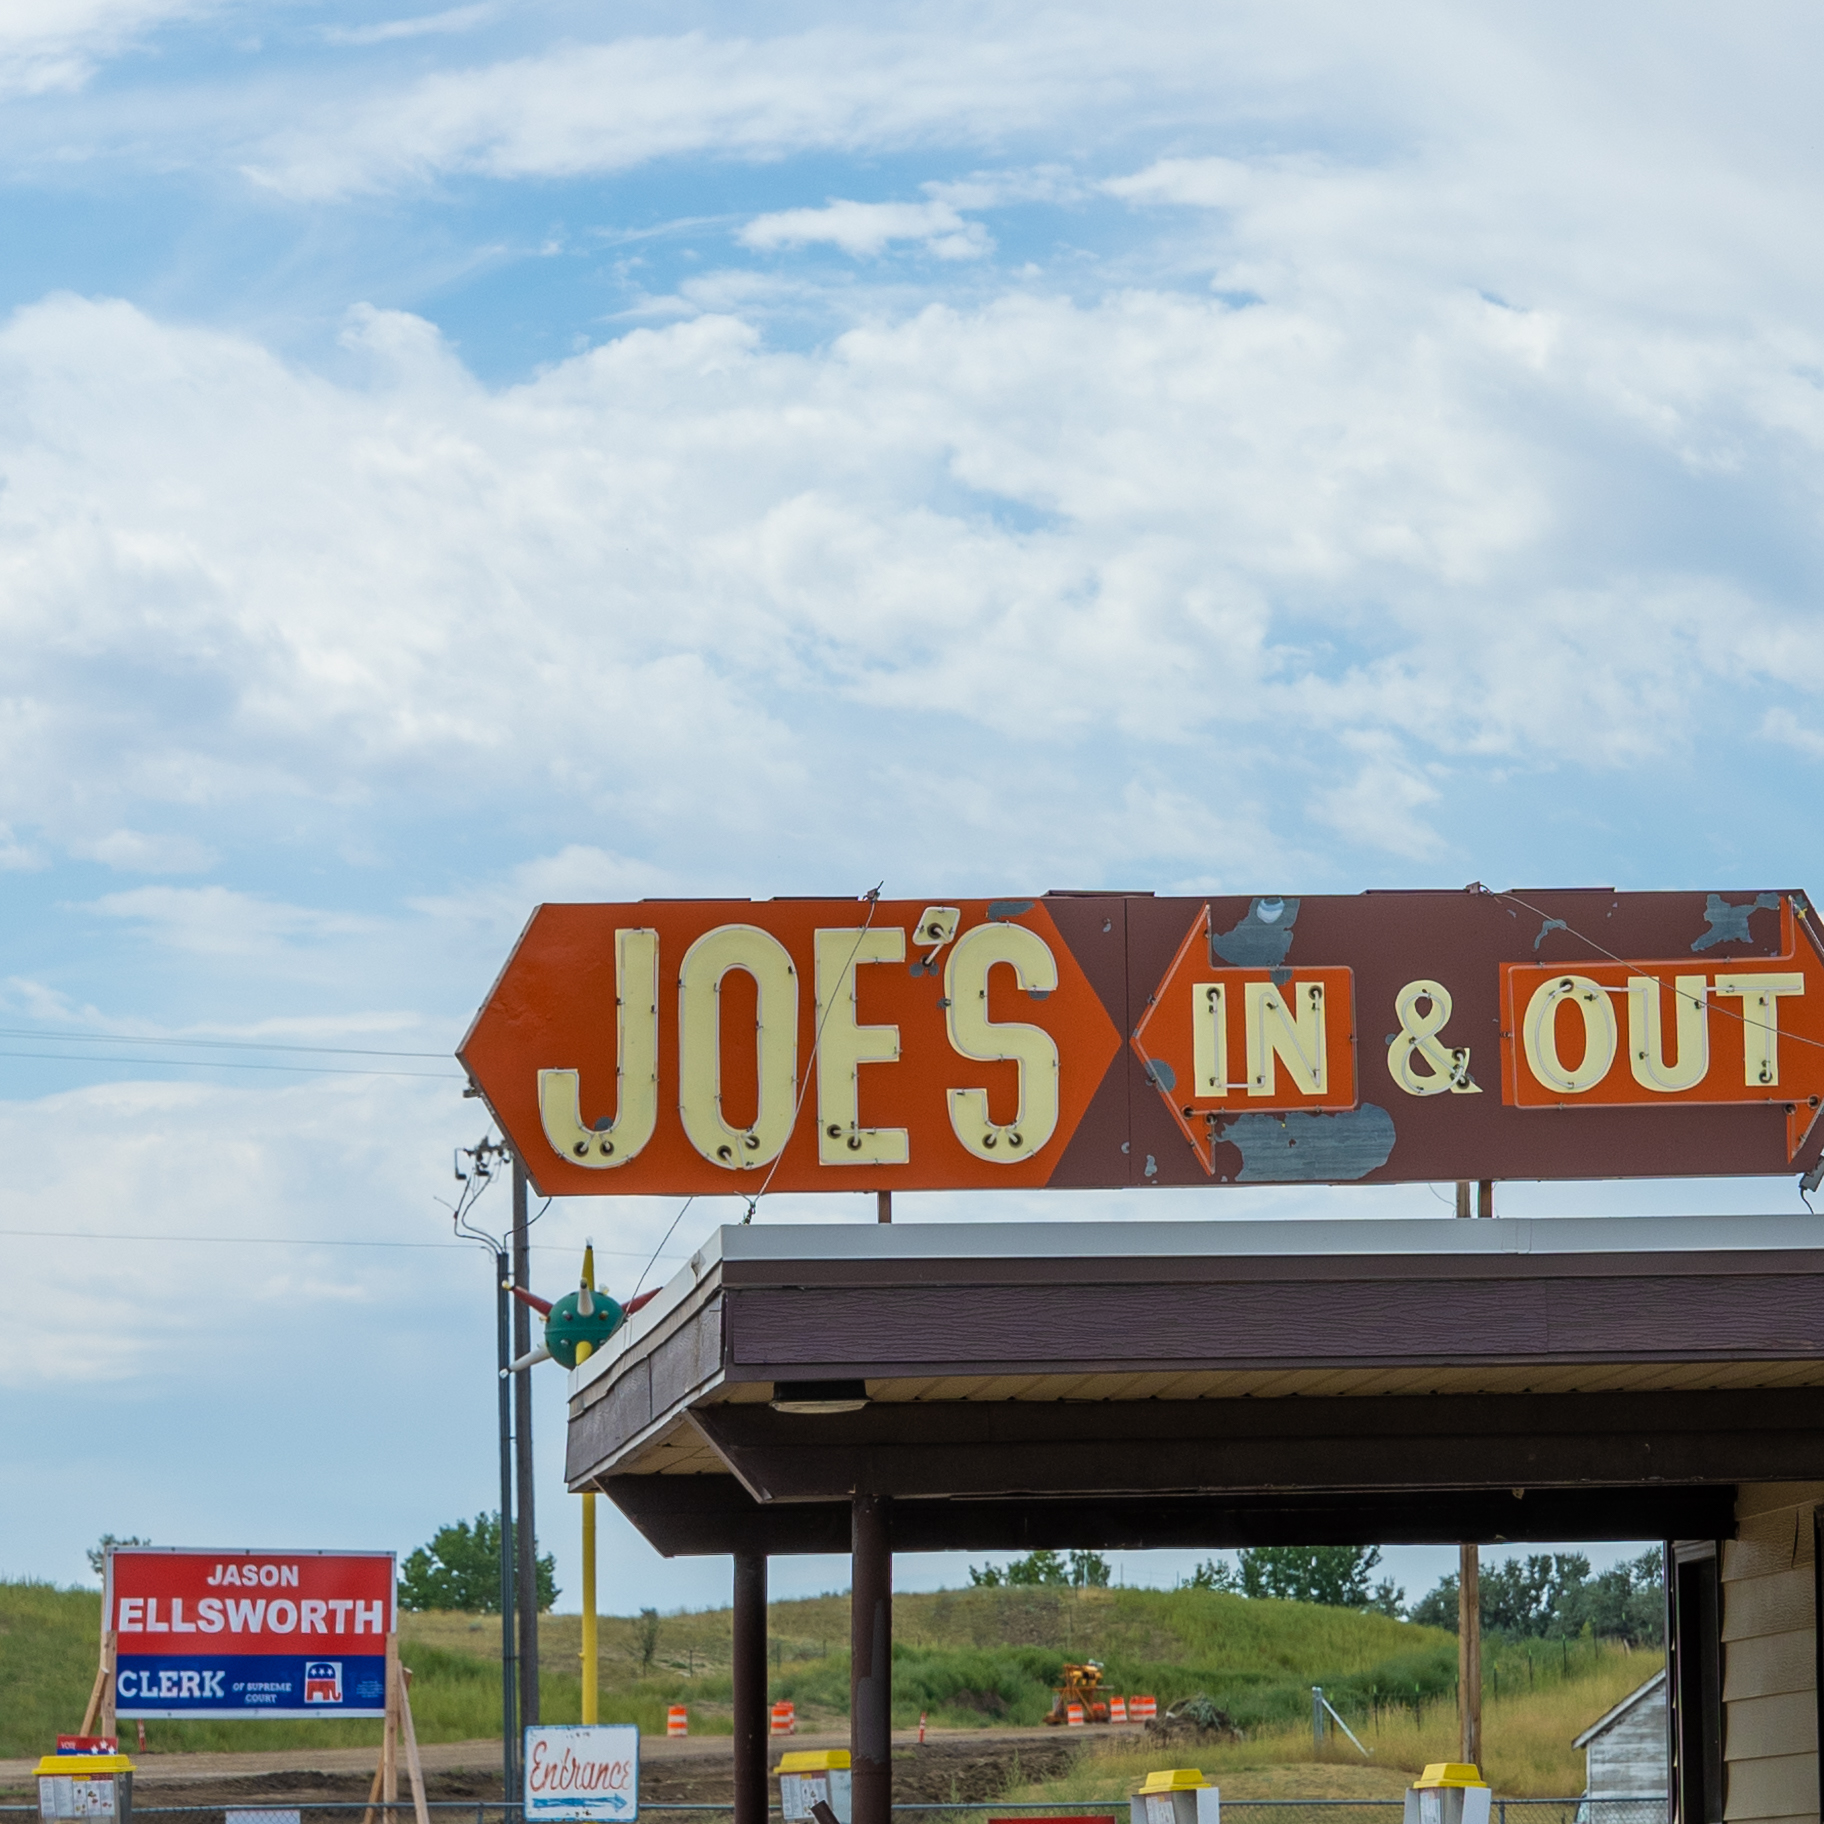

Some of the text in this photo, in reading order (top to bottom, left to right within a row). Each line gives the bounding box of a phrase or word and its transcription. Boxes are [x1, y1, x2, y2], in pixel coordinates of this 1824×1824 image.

[537, 906, 1805, 1169] JOE'S IN & OUT
[207, 1565, 299, 1586] JASON
[118, 1597, 383, 1634] ELLSWORTH
[117, 1670, 292, 1698] CLERK OF SUPREME
[245, 1693, 278, 1703] COURT
[530, 1740, 631, 1792] Entrance
